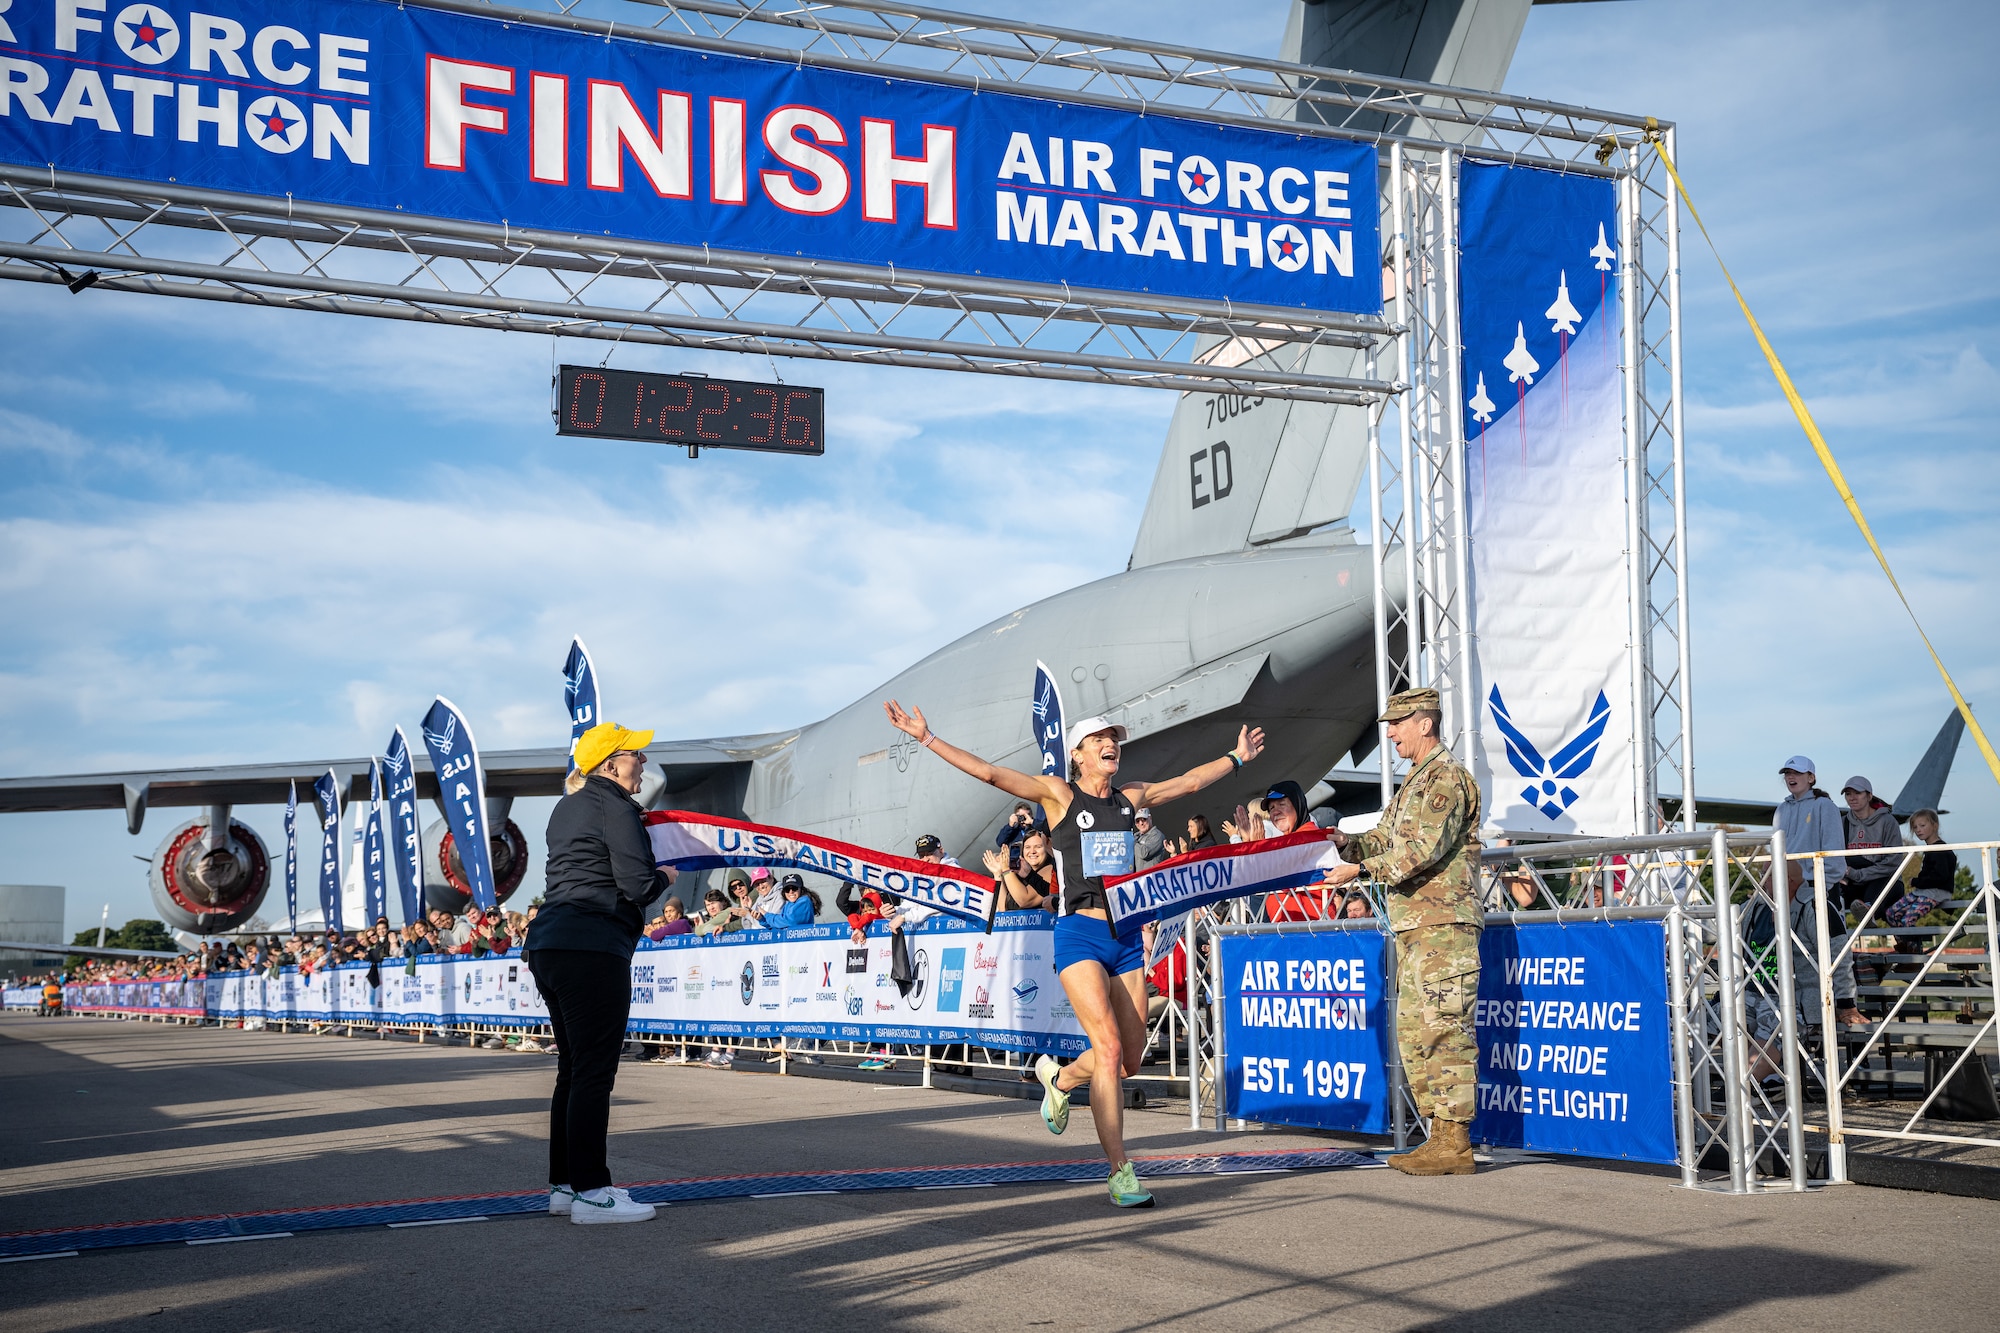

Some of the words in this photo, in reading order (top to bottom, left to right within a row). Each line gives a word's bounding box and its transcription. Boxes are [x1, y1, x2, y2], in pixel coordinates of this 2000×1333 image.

[54, 0, 370, 96] FORCE
[424, 53, 957, 231] FINISH
[997, 131, 1116, 193] AIR
[1140, 147, 1351, 220] FORCE
[996, 191, 1354, 278] MARATHON
[1190, 440, 1233, 510] ED
[718, 828, 784, 858] U.S.
[796, 844, 853, 877] AIR
[862, 863, 984, 914] FORCE
[1093, 842, 1127, 857] 2736
[1117, 859, 1233, 915] MARATHON
[1240, 961, 1280, 991] AIR
[1286, 959, 1366, 992] FORCE
[1504, 957, 1585, 985] WHERE
[816, 992, 837, 1001] EXCHANGE
[1241, 997, 1367, 1030] MARATHON
[1242, 1056, 1294, 1094] EST.
[1302, 1059, 1367, 1100] 1997
[1489, 1042, 1532, 1071] AND
[1538, 1044, 1609, 1076] PRIDE
[1478, 1083, 1533, 1114] TAKE
[1537, 1087, 1628, 1122] FLIGHT!
